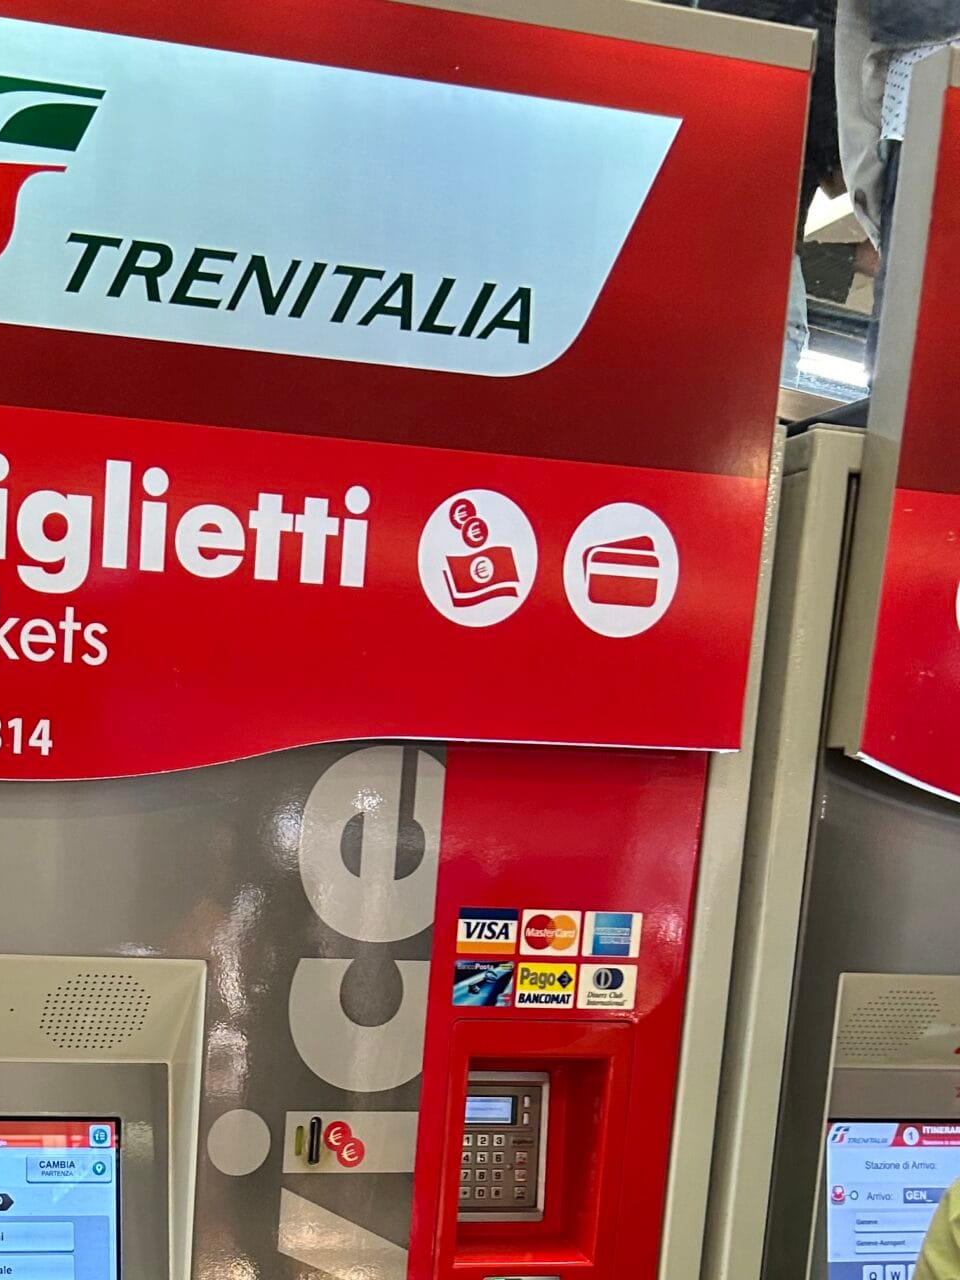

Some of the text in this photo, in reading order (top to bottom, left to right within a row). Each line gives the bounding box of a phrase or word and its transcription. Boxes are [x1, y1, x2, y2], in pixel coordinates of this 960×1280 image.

[62, 231, 535, 346] TRENITALIA
[463, 921, 511, 940] VISA
[525, 927, 576, 939] MasterCard
[519, 967, 556, 990] Pago
[518, 992, 572, 1005] BANCOMAT
[609, 991, 623, 999] Club
[480, 1136, 487, 1145] 2
[496, 1136, 502, 1145] 3
[39, 1160, 76, 1169] CAMBIA
[865, 1160, 937, 1169] Stazione di Arrivo:
[866, 1192, 893, 1200] Arrivo:
[869, 1271, 900, 1280] Q W
